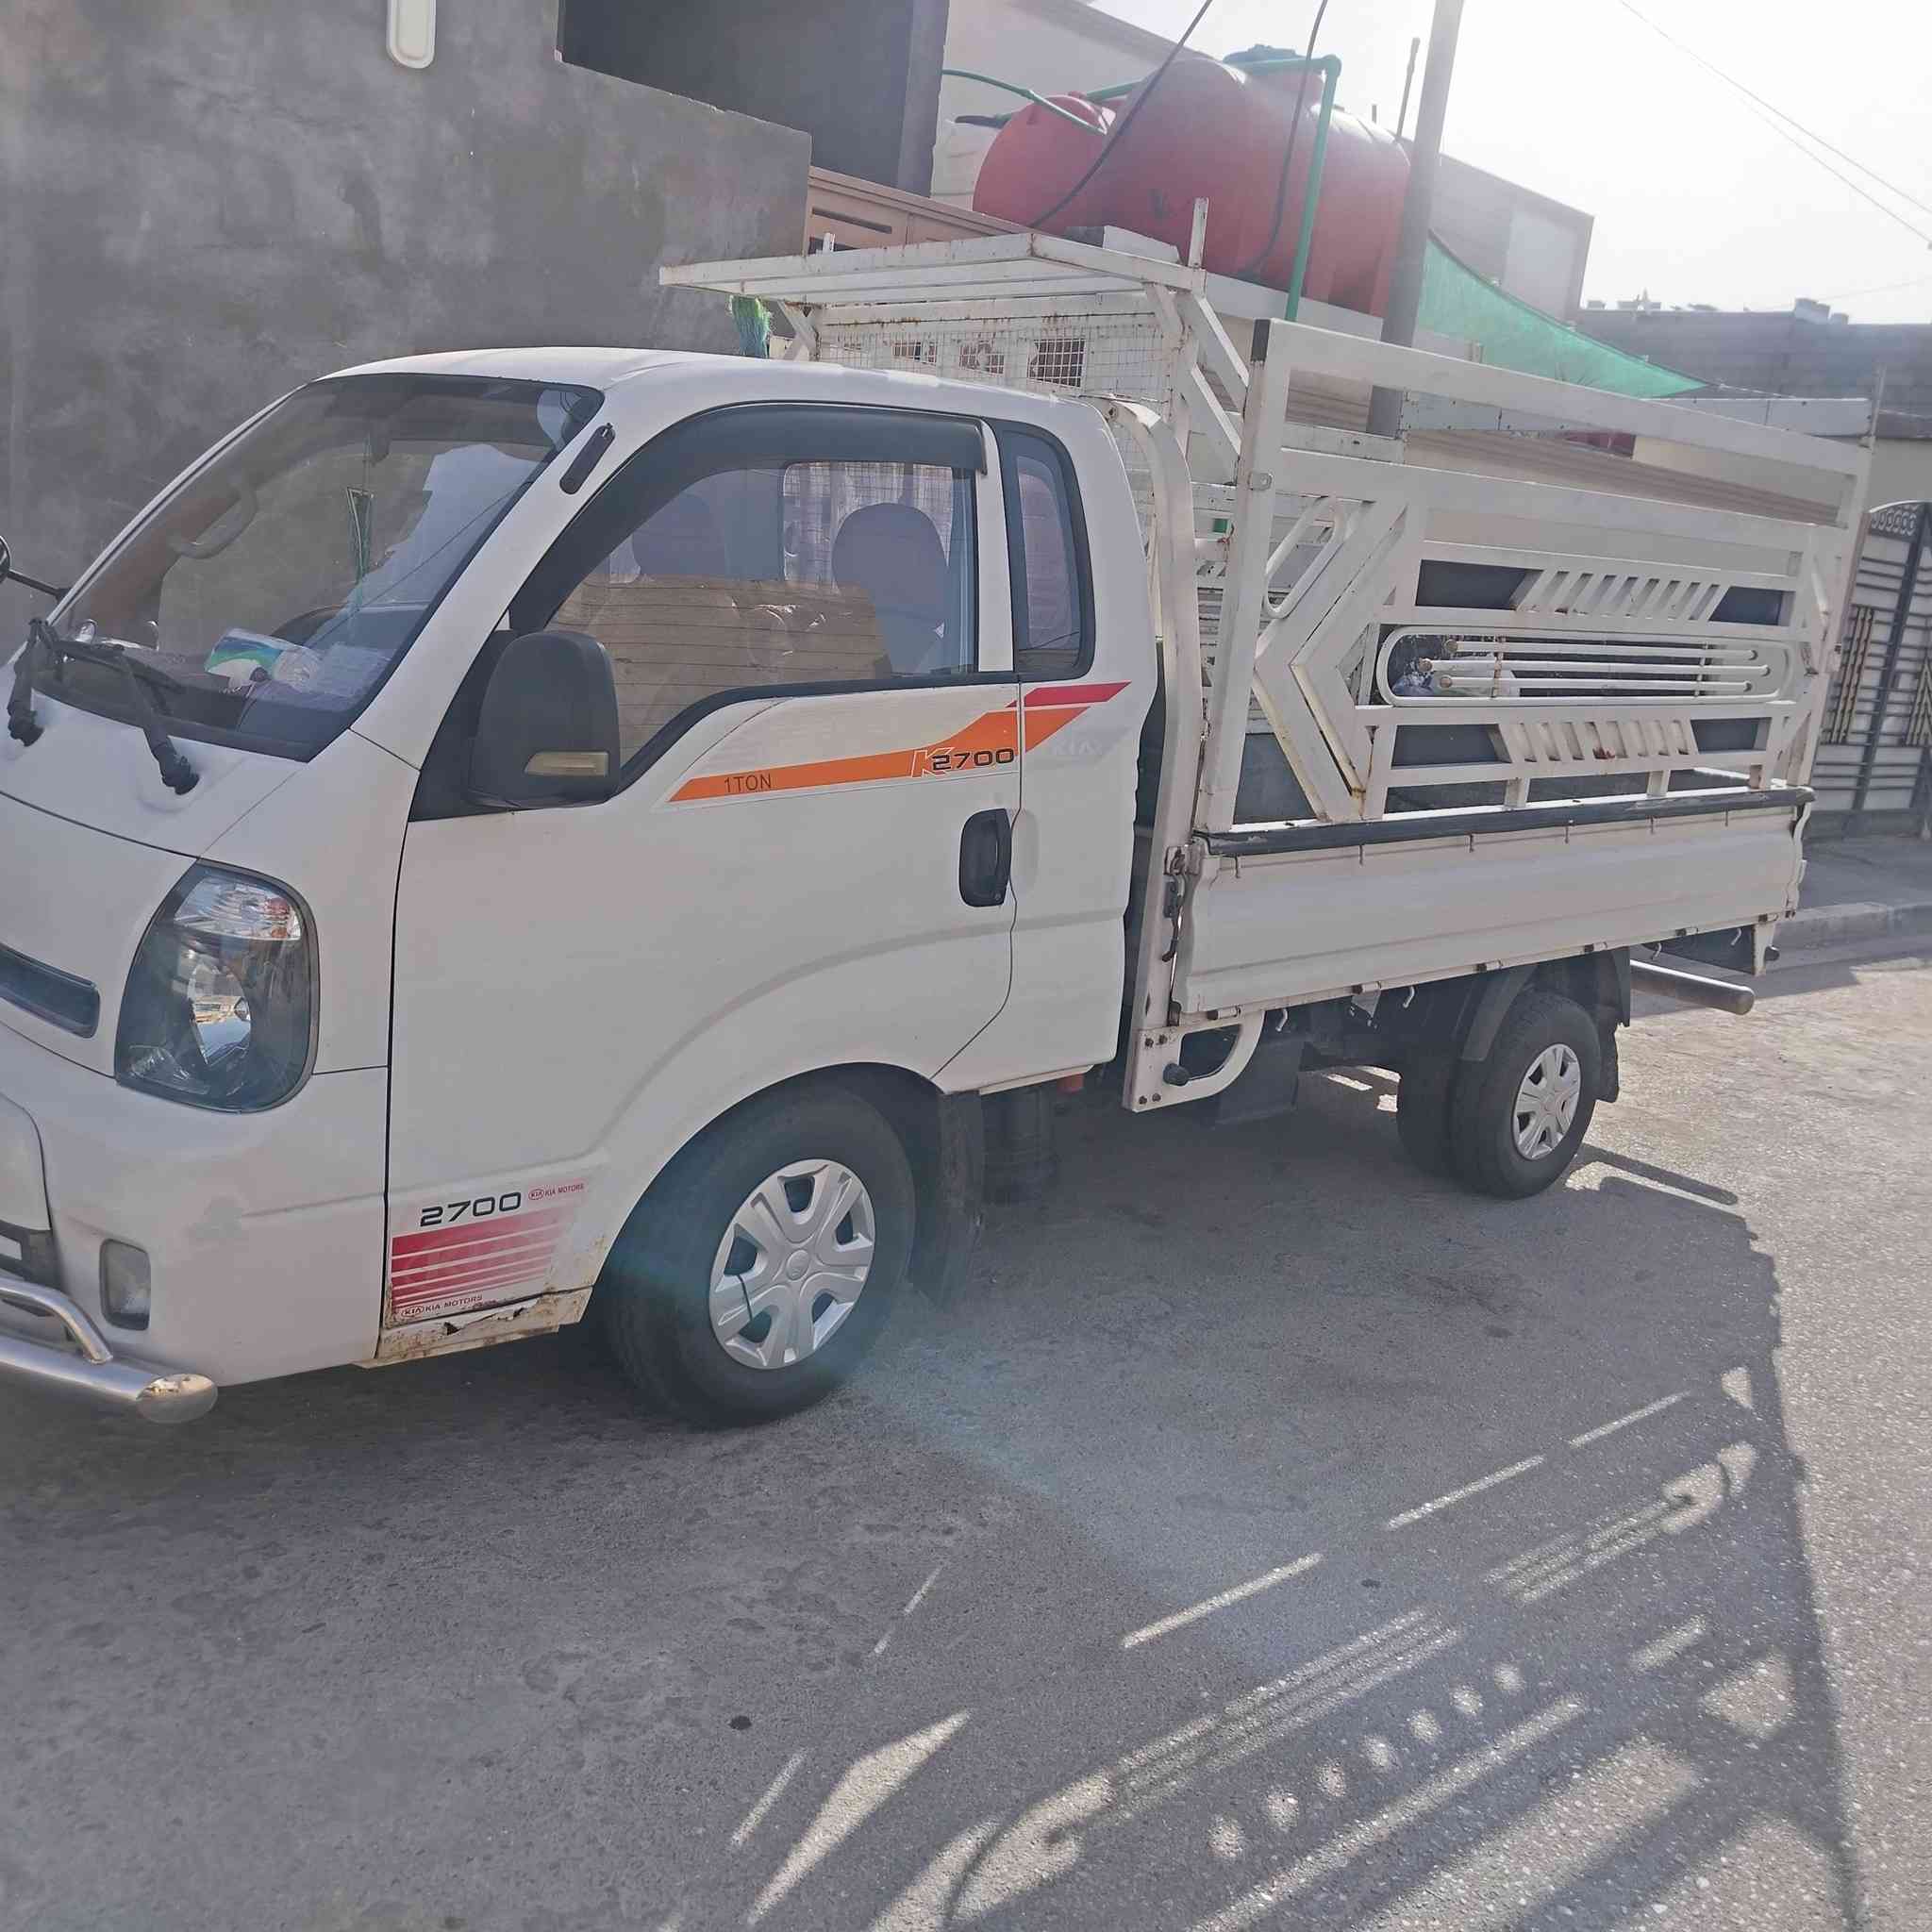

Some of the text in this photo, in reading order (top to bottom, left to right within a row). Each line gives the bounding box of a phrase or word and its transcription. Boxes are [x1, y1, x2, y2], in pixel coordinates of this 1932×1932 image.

[420, 1191, 522, 1227] 2700
[425, 1304, 441, 1312] KIA
[444, 1294, 483, 1307] MOTORS
